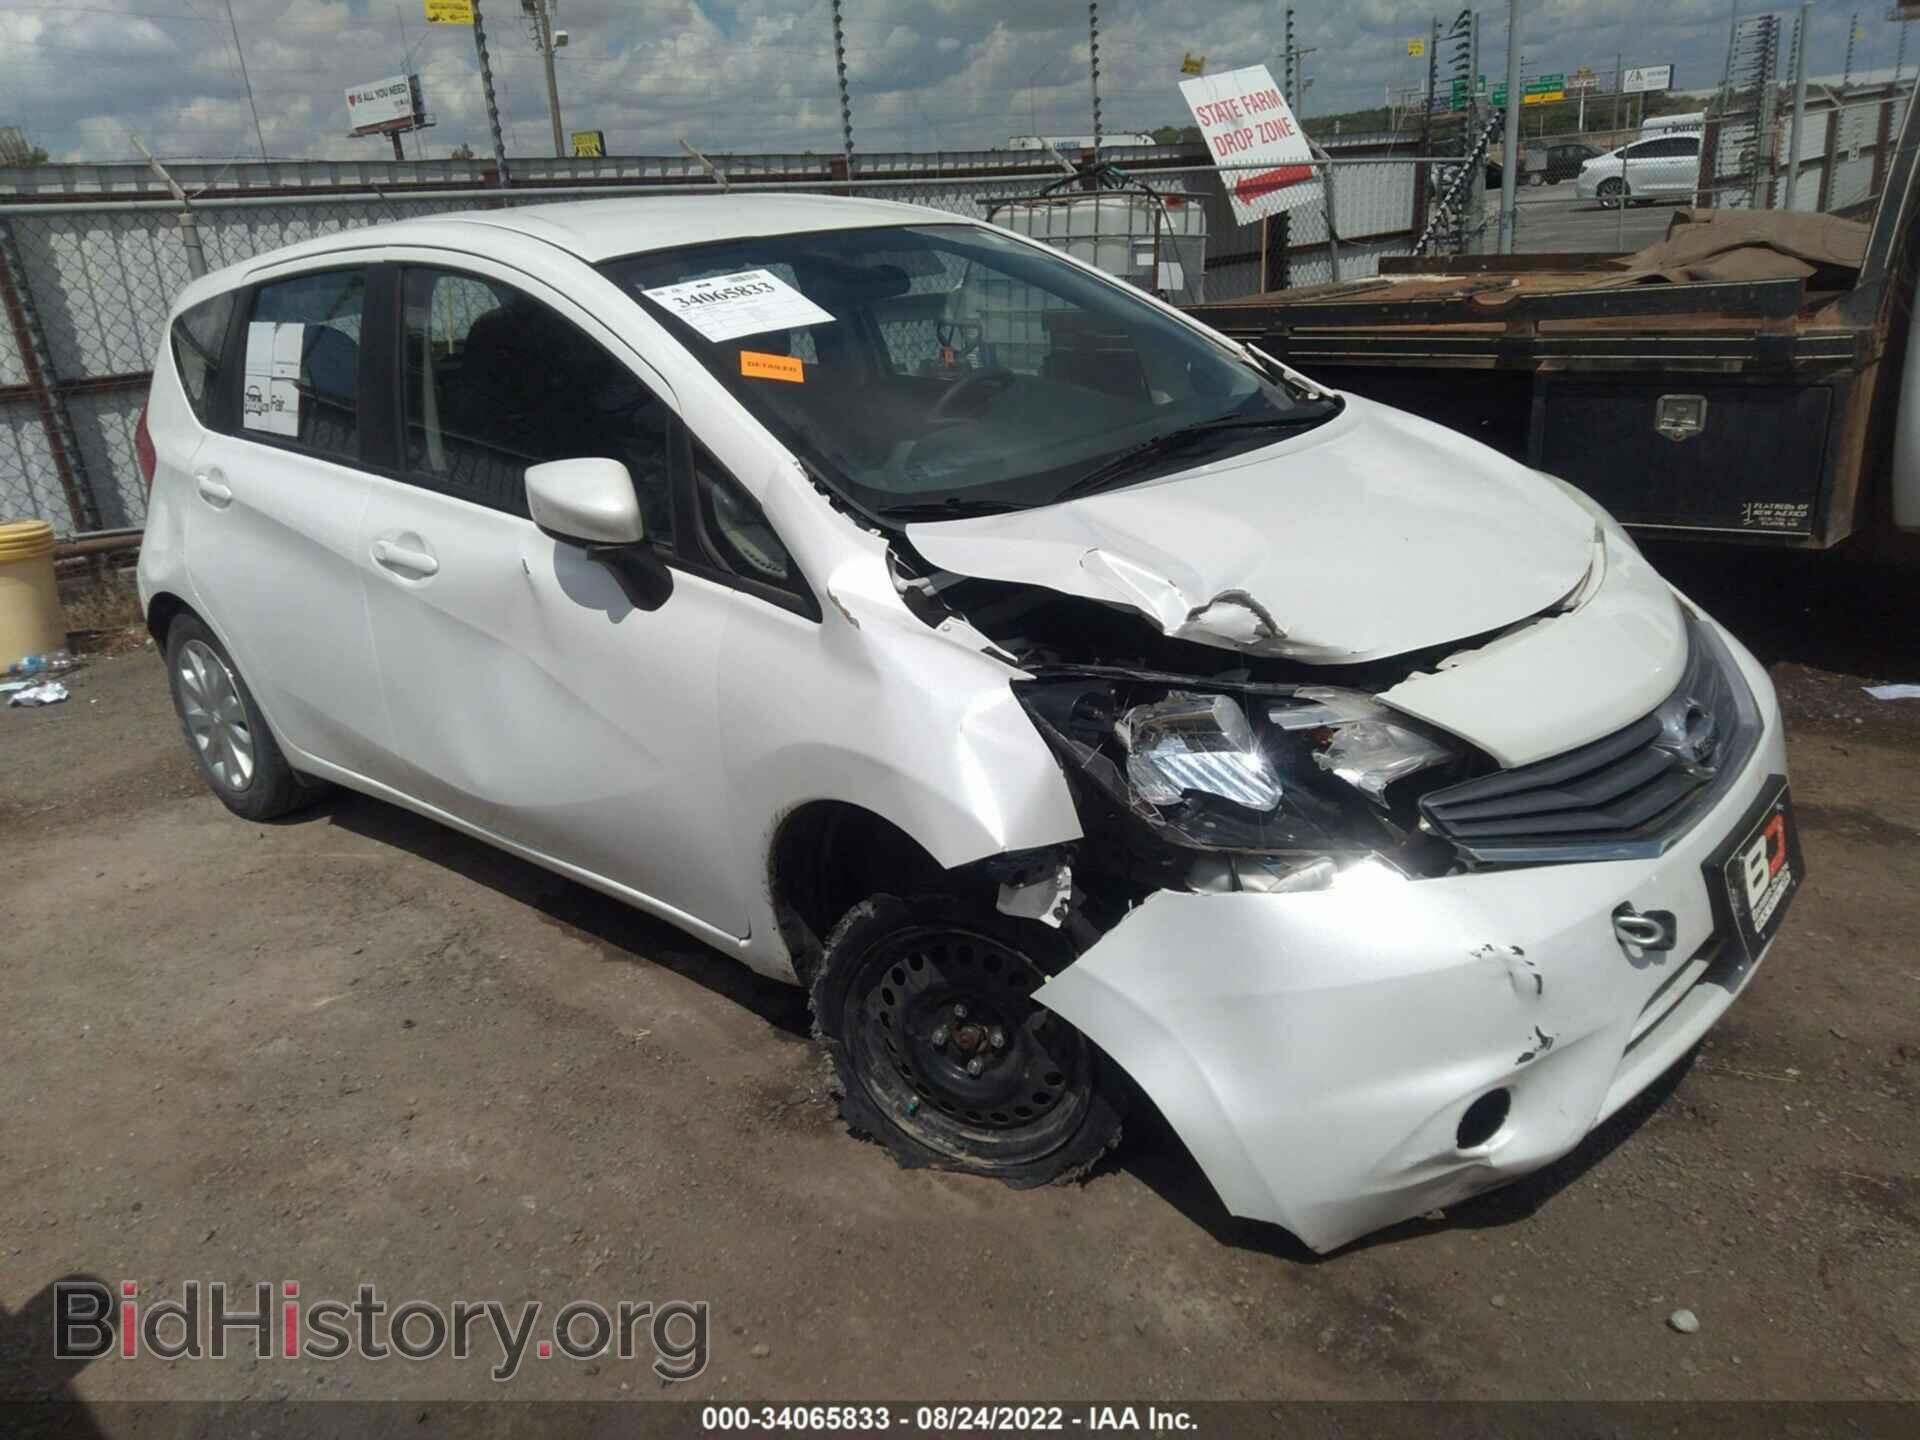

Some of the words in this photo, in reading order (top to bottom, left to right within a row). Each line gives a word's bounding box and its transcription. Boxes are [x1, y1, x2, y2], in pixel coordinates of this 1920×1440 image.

[363, 90, 375, 101] ALL
[375, 88, 388, 98] YOU
[388, 83, 407, 95] NEED
[1196, 98, 1243, 127] STATE
[1240, 89, 1283, 114] FARM
[1213, 127, 1255, 157] DROP
[1255, 116, 1296, 144] ZONE
[672, 282, 776, 308] 34065833
